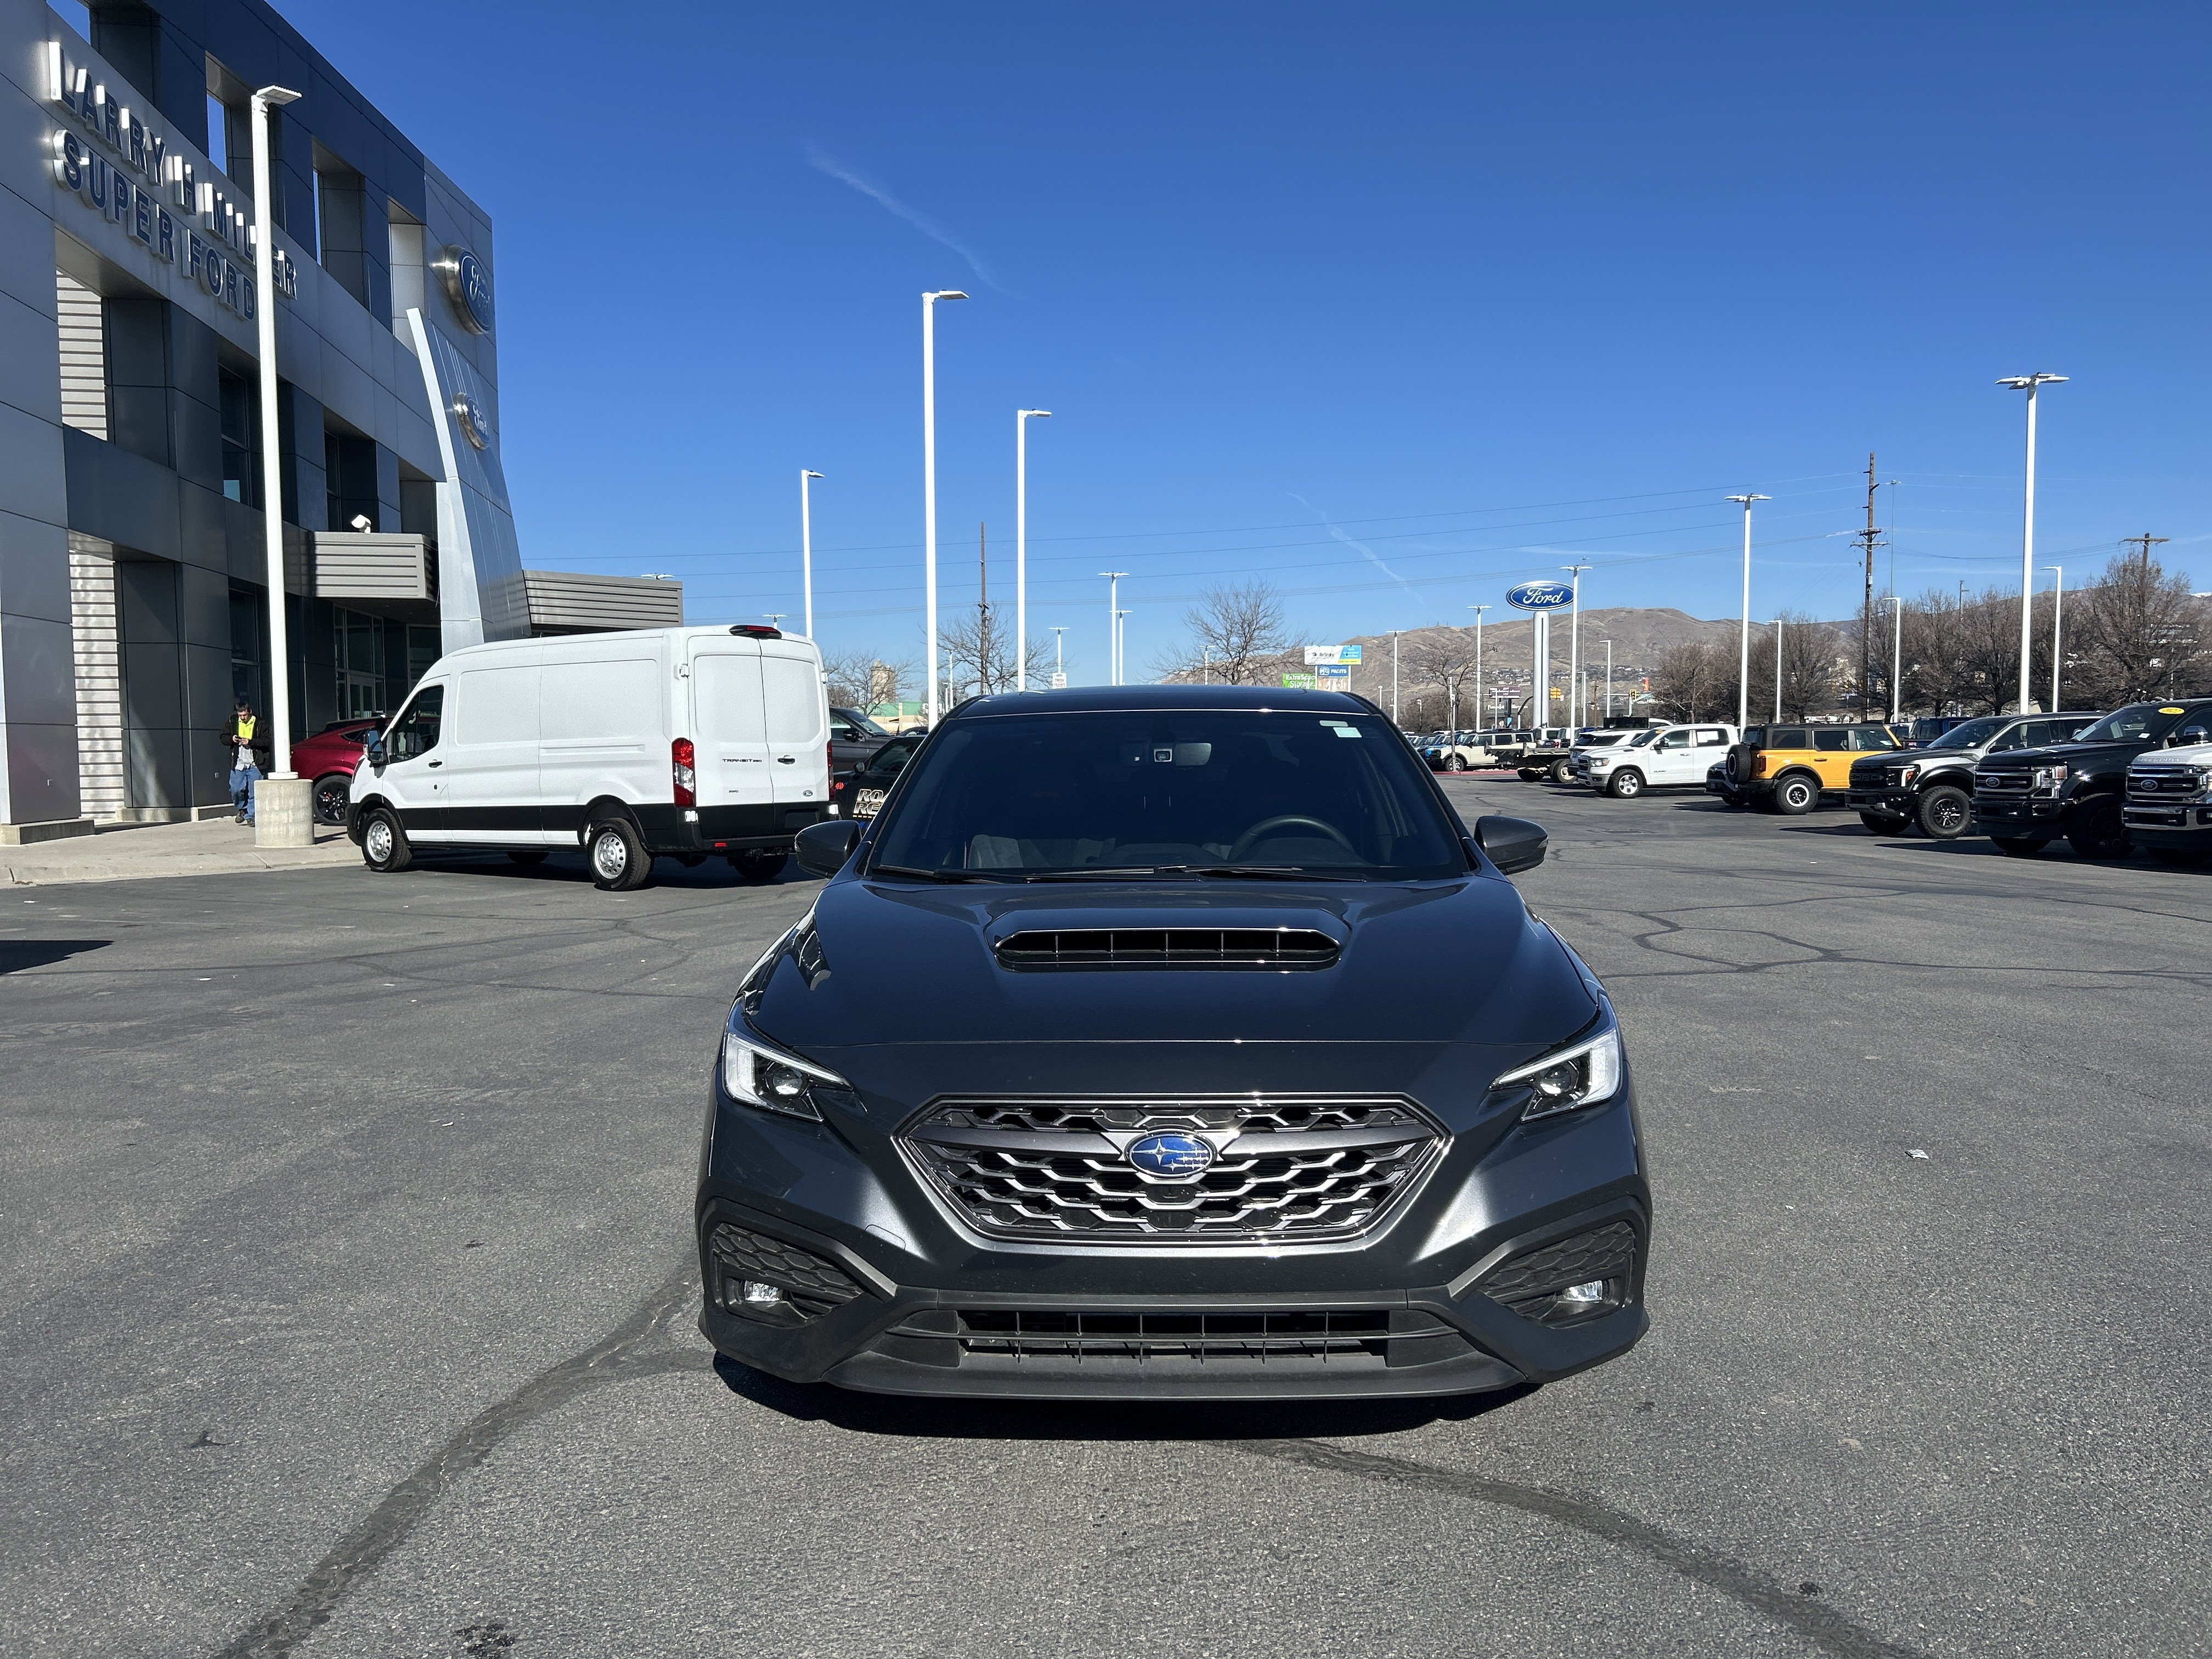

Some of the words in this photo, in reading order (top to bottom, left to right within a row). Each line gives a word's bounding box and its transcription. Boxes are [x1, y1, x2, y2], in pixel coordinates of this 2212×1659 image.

[49, 42, 166, 188] LARRY
[173, 156, 196, 216] H
[204, 183, 297, 301] MILER
[53, 129, 175, 264] SUPER
[181, 229, 256, 320] FORD
[1523, 587, 1564, 604] Ford
[853, 801, 884, 815] RE
